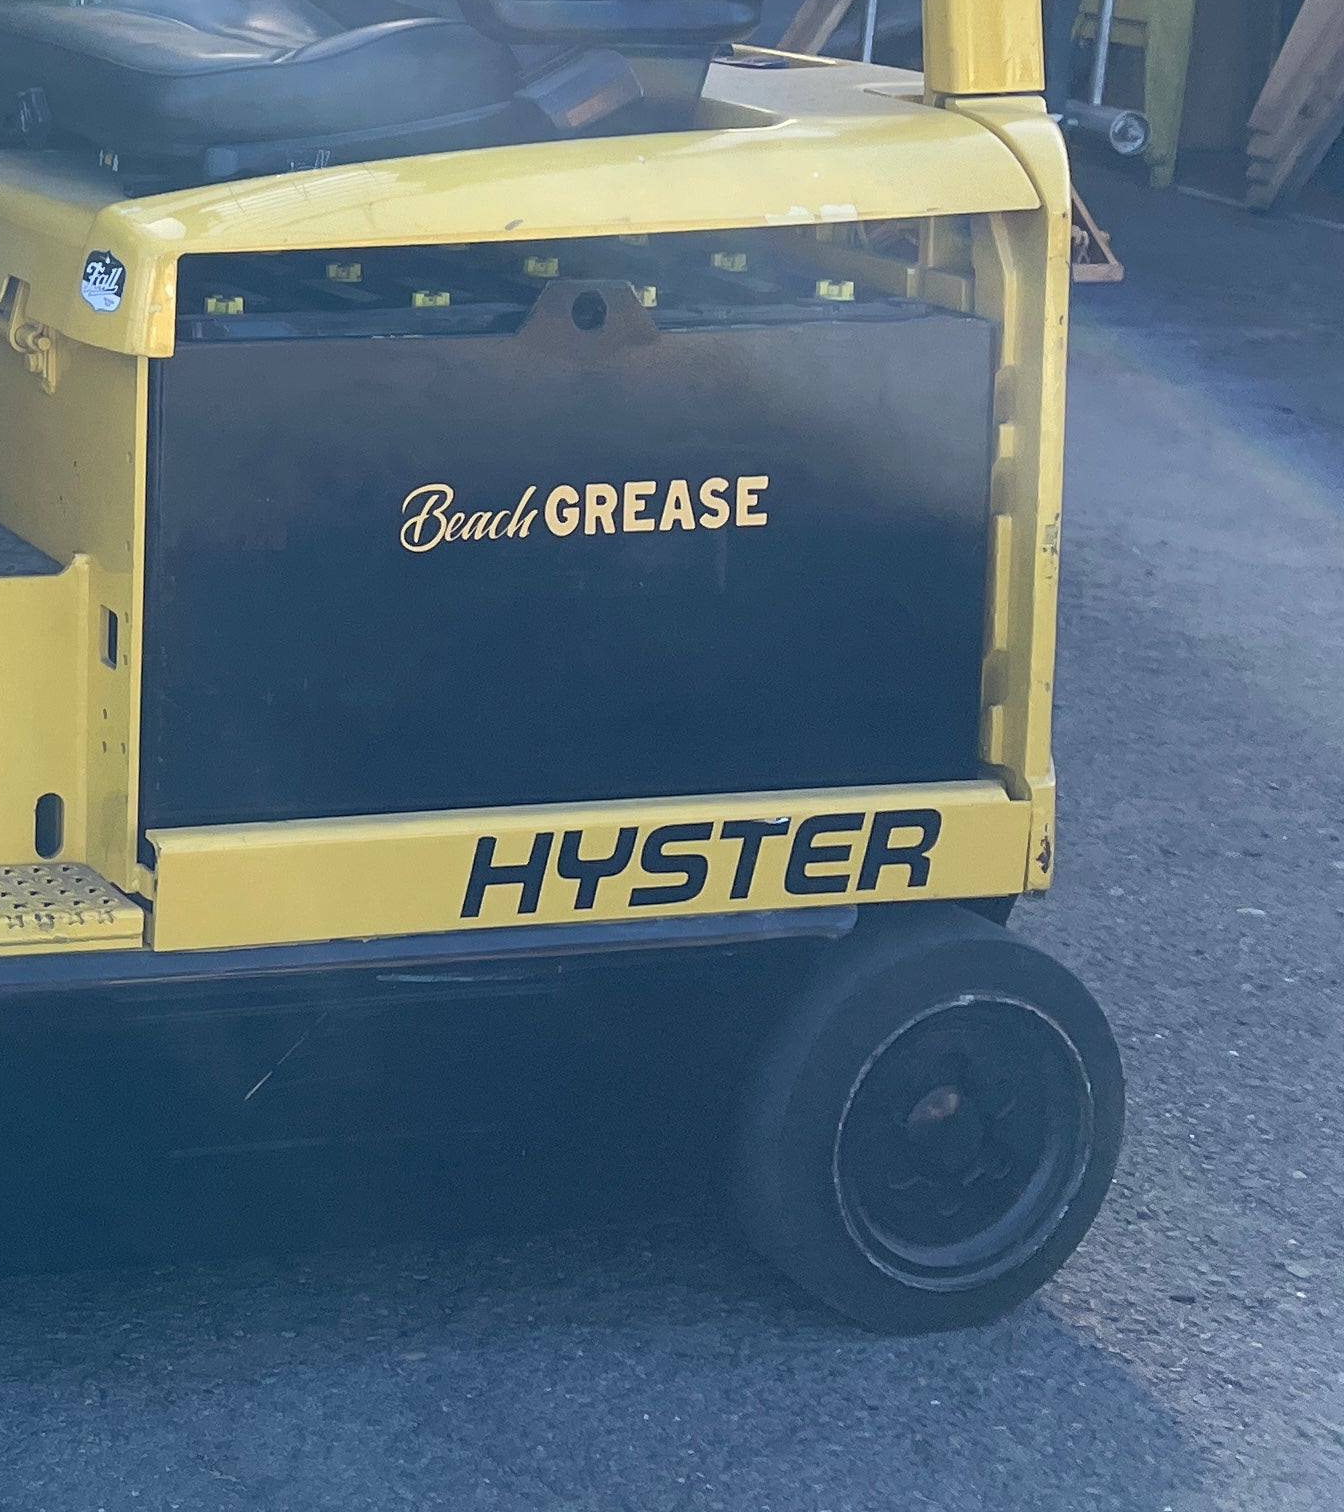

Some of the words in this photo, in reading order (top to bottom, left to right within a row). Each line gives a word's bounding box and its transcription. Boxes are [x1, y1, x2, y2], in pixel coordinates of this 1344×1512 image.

[400, 483, 539, 552] Beach
[543, 475, 770, 537] GREASE
[460, 807, 941, 919] HYSTER
